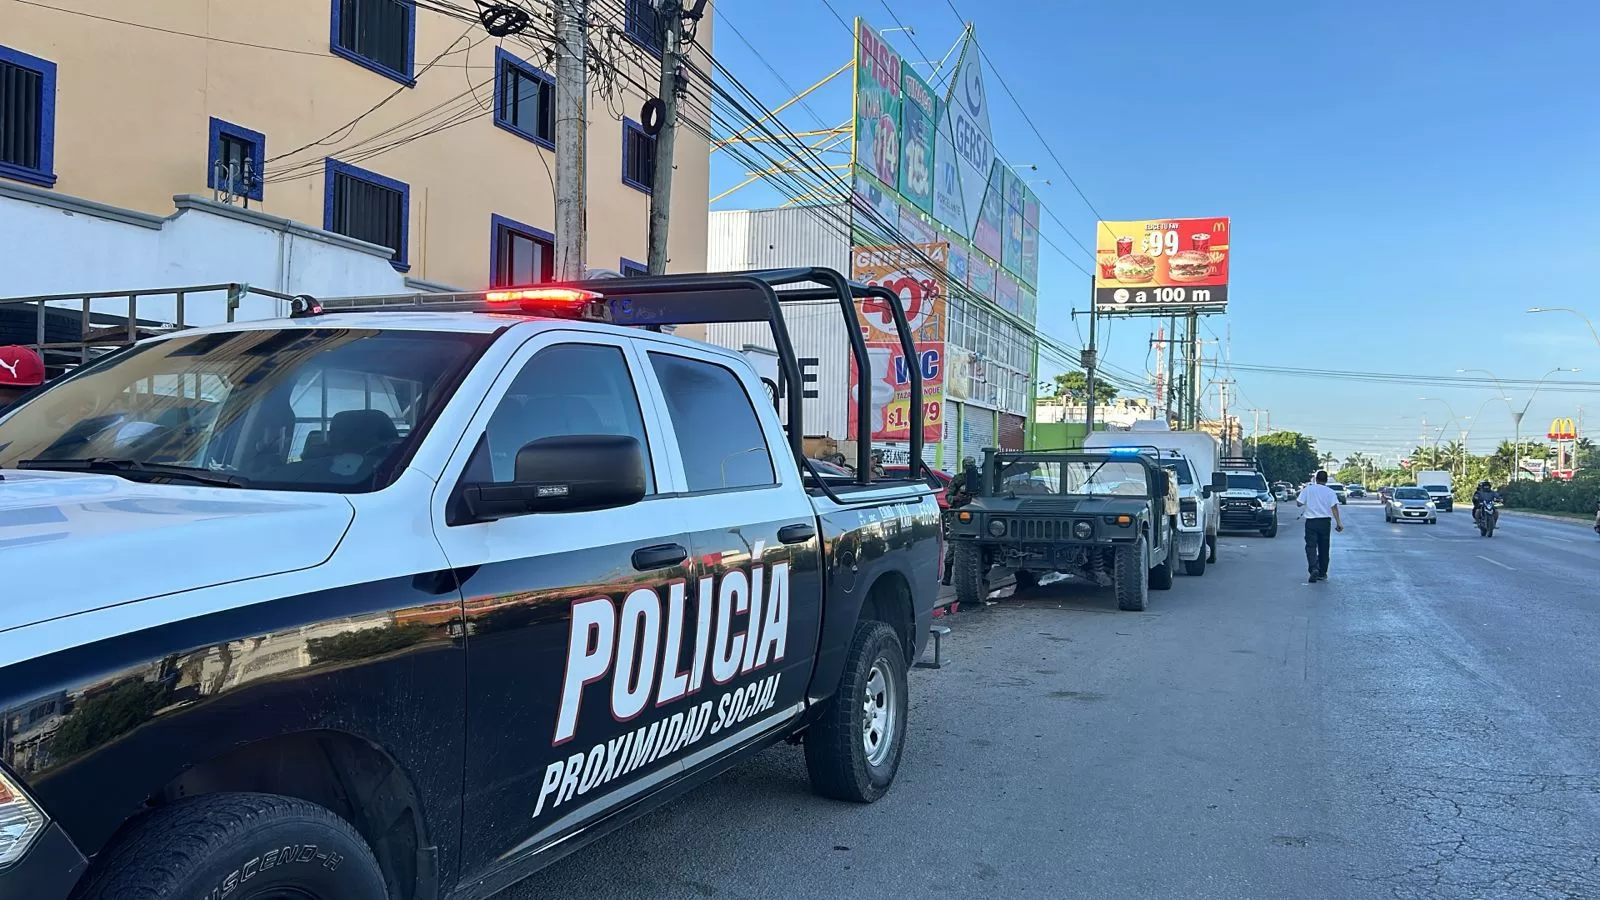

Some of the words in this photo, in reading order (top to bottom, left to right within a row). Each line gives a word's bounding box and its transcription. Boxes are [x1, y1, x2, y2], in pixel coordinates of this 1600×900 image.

[861, 23, 900, 97] PISO
[956, 114, 988, 178] GERSA
[1136, 291, 1147, 302] a
[1153, 287, 1186, 302] 100
[1192, 289, 1211, 301] m
[552, 540, 790, 746] POLICÍA
[532, 700, 713, 818] PROXIMIDAD
[711, 673, 781, 735] SOCIAL
